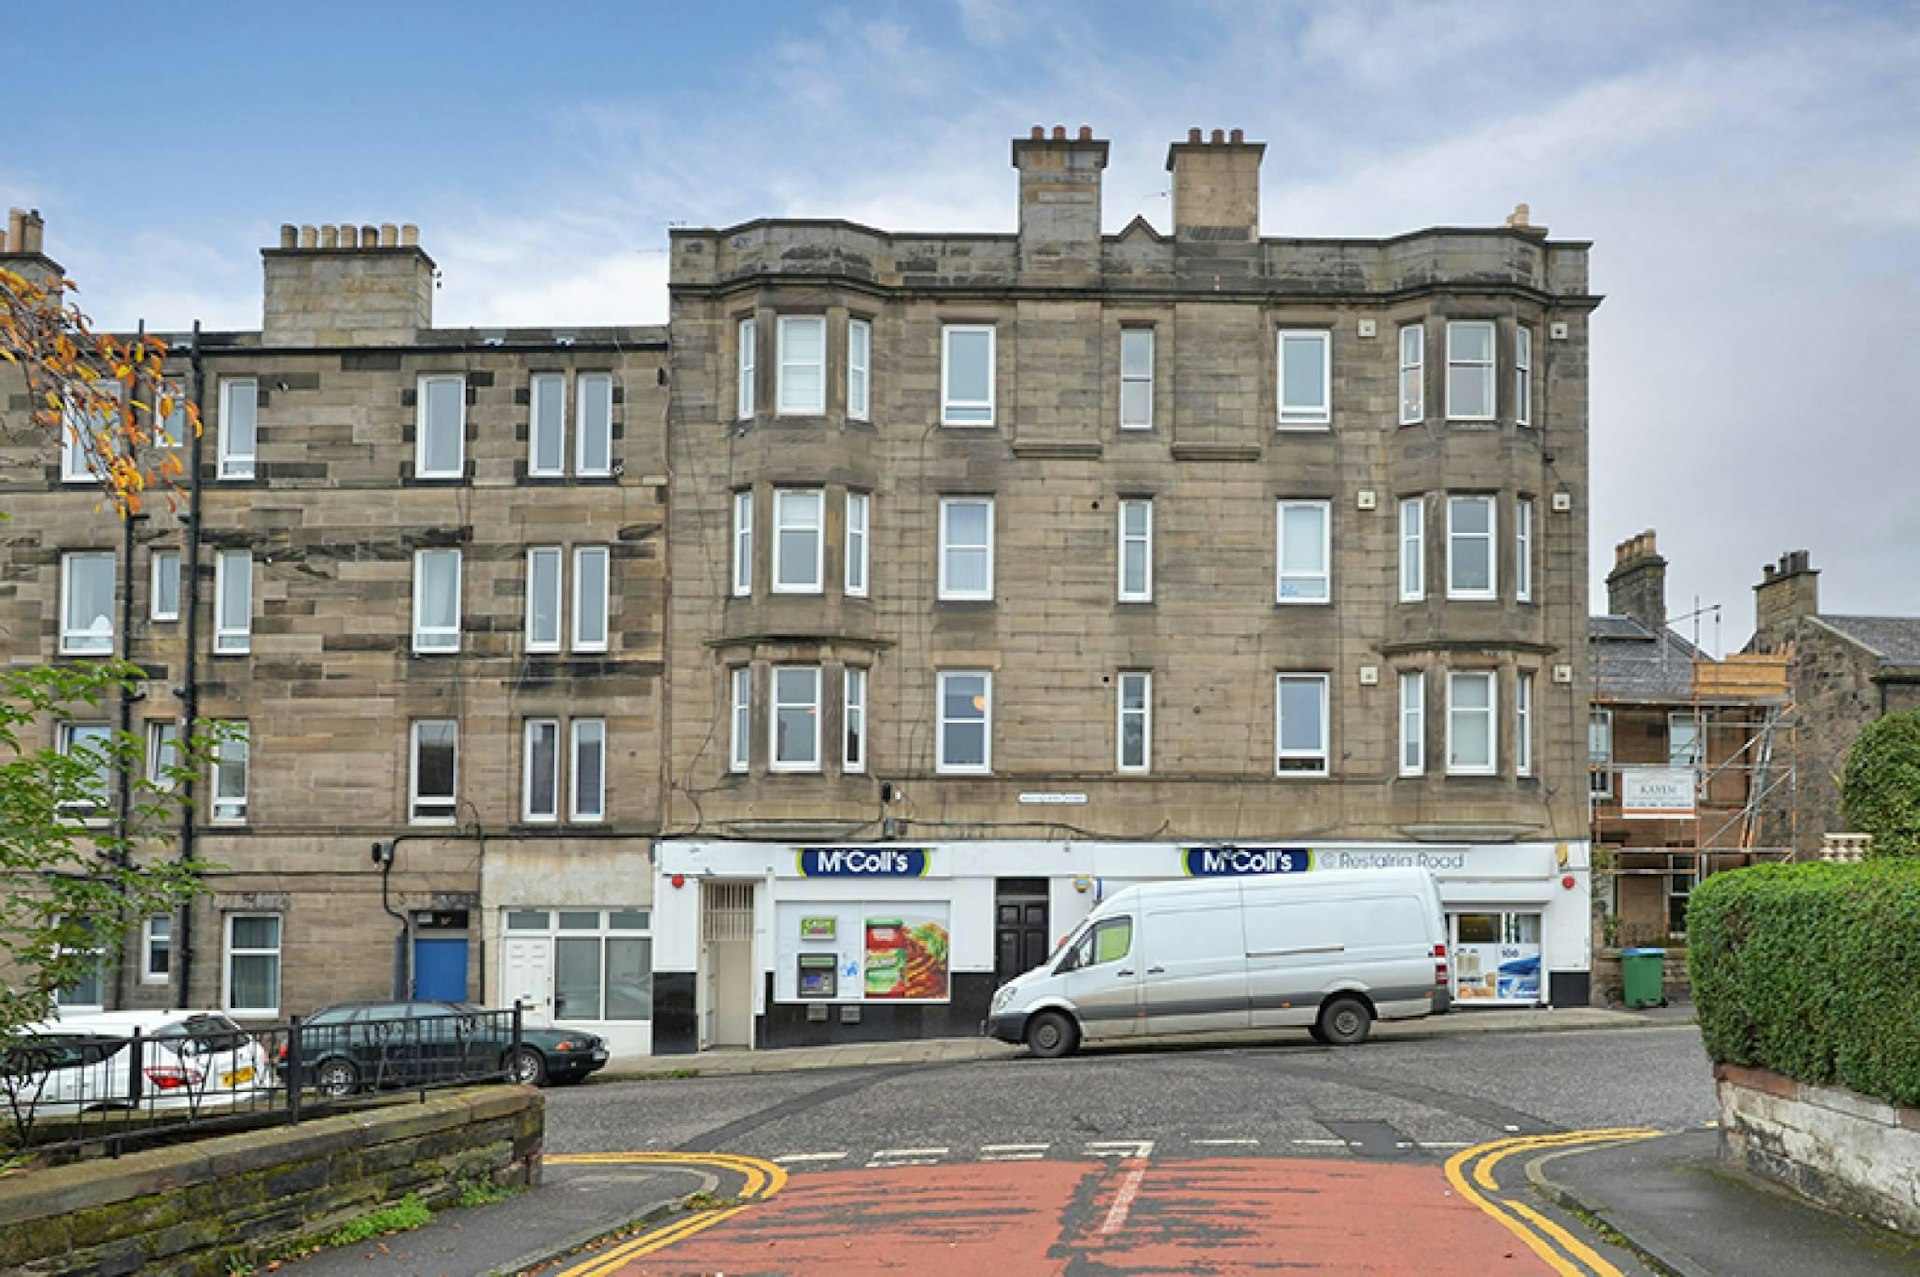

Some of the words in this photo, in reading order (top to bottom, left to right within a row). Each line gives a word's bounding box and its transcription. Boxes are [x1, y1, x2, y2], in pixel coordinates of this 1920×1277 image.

[817, 850, 909, 873] McColl's
[1203, 849, 1293, 873] McColl's
[1417, 851, 1465, 870] Road
